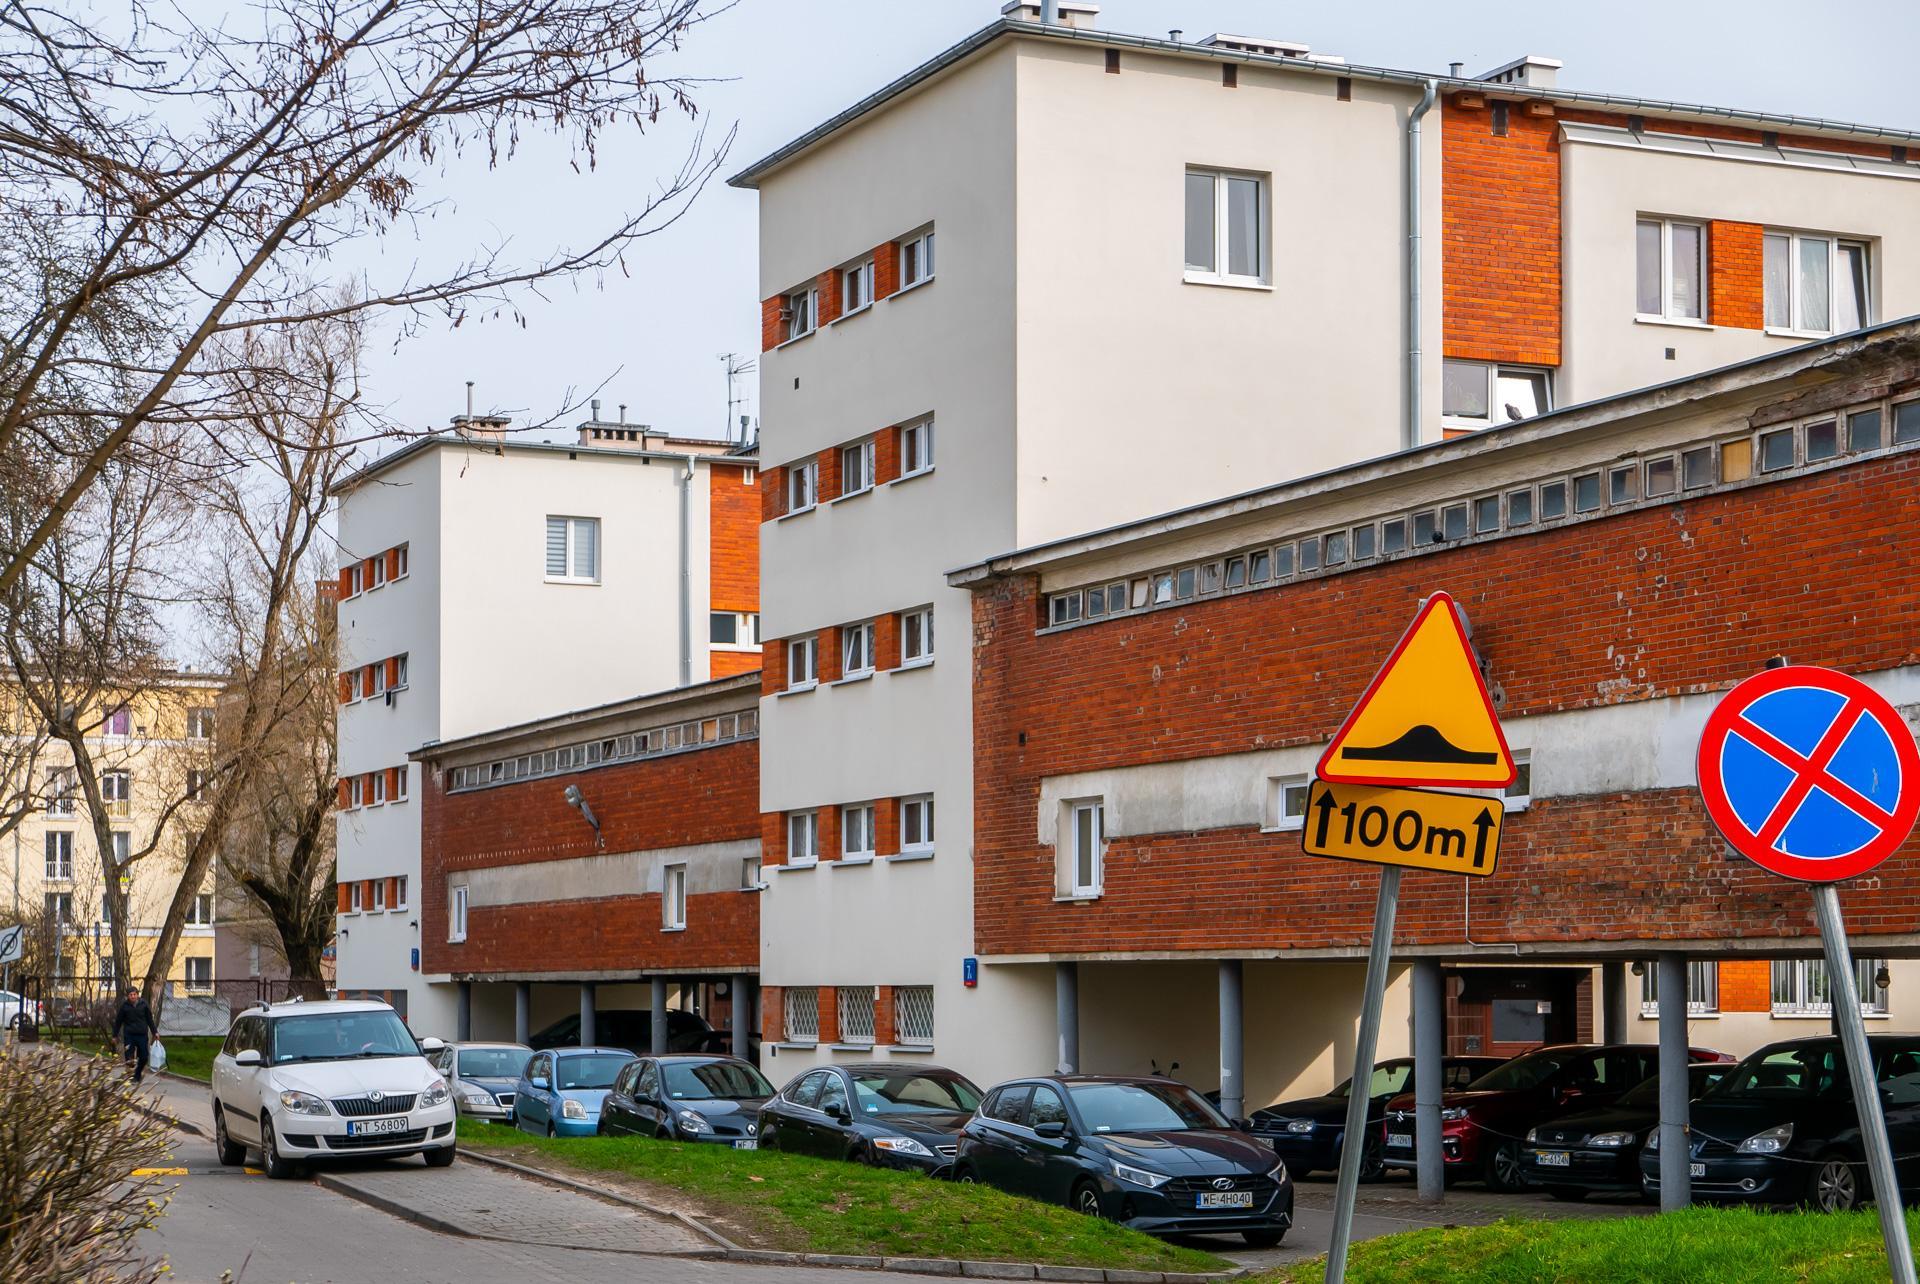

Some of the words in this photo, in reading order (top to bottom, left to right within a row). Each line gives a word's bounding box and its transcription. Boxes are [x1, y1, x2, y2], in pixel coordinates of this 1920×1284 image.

[1341, 802, 1467, 858] 100m
[355, 1121, 369, 1133] WT
[374, 1119, 406, 1131] 56809
[1203, 1193, 1216, 1205] WE
[1220, 1192, 1250, 1204] 4H040
